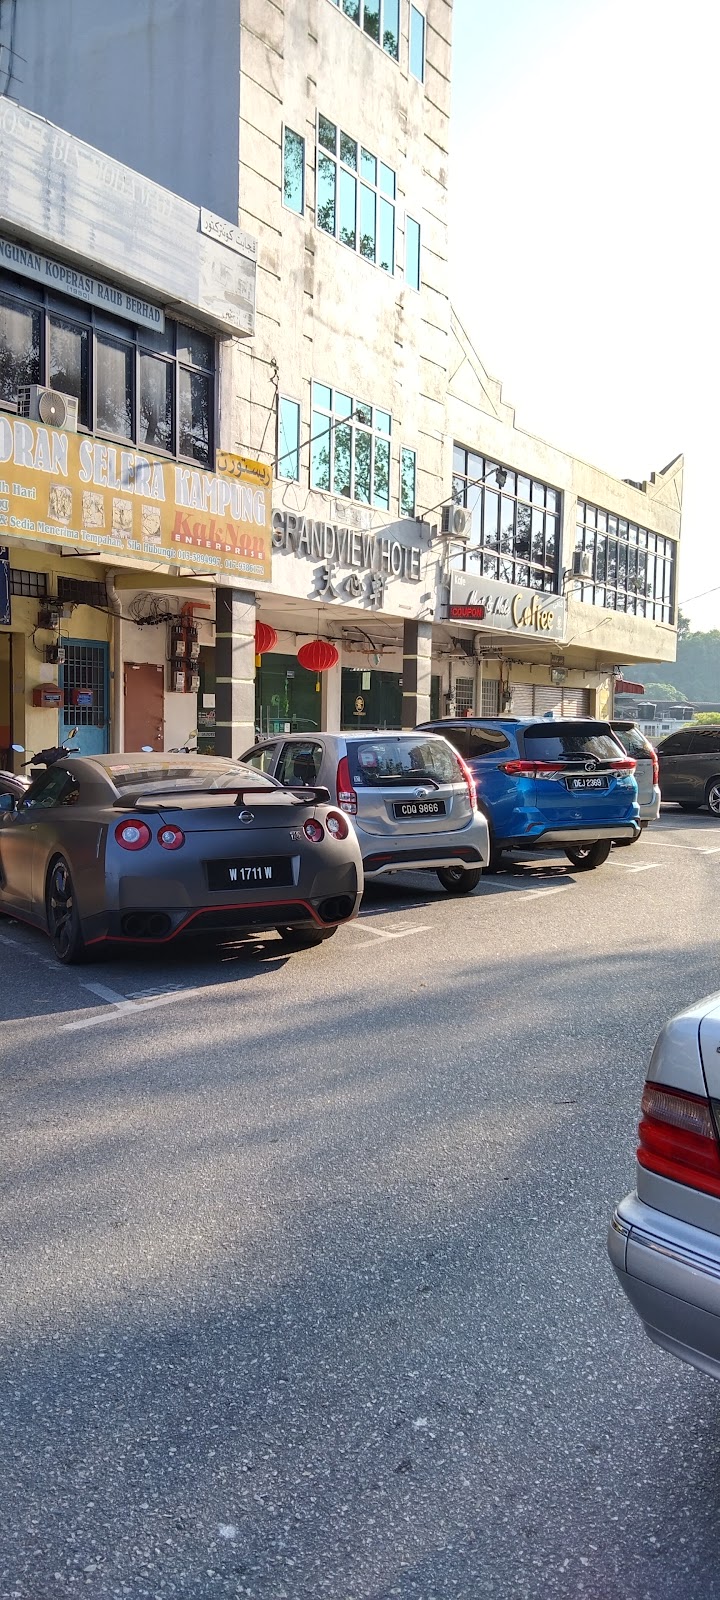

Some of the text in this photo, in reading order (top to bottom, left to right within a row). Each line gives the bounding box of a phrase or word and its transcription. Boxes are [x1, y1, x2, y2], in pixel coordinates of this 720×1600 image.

[45, 261, 94, 295] KOPERASI
[97, 283, 123, 307] RAUB
[125, 294, 161, 322] BERHAD
[12, 482, 37, 500] Hari
[79, 440, 165, 502] SELERA
[174, 466, 266, 527] KAMPUNG
[9, 516, 36, 531] Sedia
[37, 521, 80, 540] Menerima
[81, 530, 125, 549] Tempahan,
[127, 539, 142, 552] Sila
[174, 533, 263, 560] ENTERPRISE
[272, 508, 377, 571] GRANDVIEW
[379, 537, 423, 581] HOTEL
[451, 607, 482, 618] COUPON
[511, 592, 555, 632] Coffee
[573, 778, 586, 788] DEJ
[401, 802, 439, 815] CDQ 9866
[229, 866, 272, 881] W 1711 W
